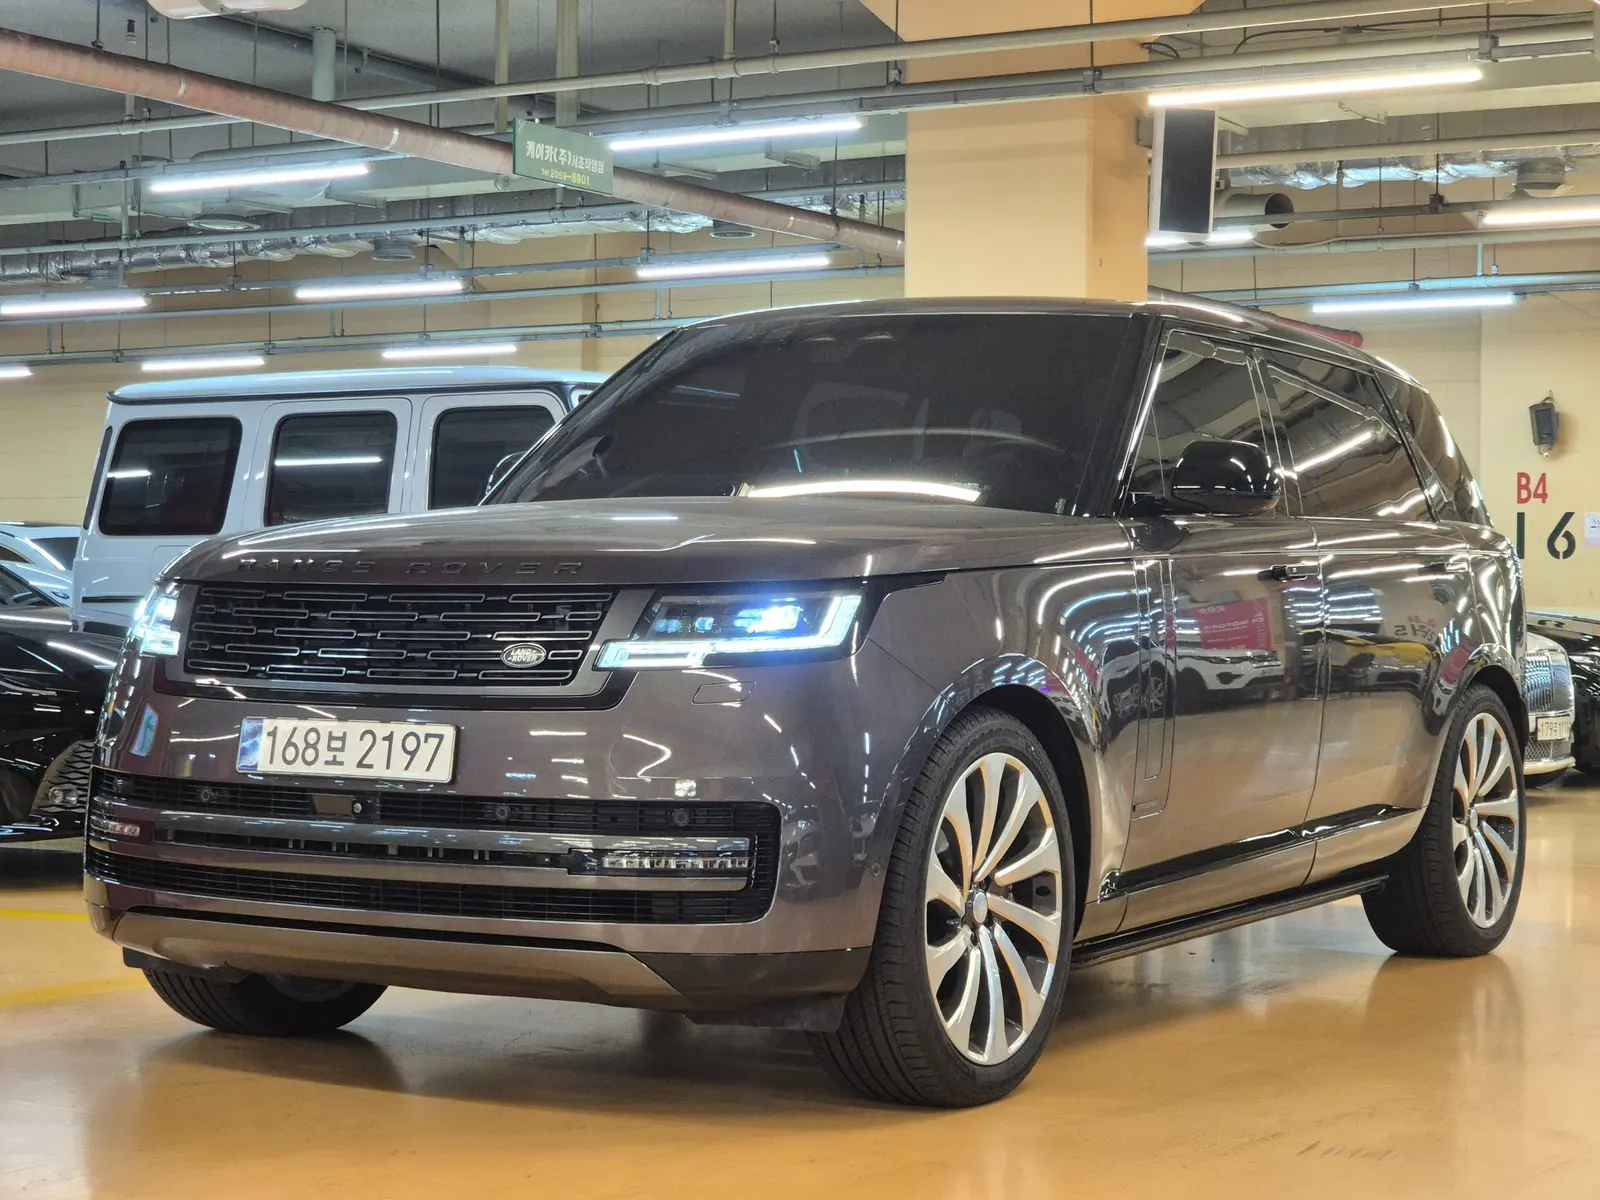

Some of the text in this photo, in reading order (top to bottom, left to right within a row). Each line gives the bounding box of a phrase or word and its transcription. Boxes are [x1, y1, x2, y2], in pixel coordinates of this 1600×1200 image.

[550, 169, 590, 186] 2059-8901
[1516, 472, 1548, 504] B4
[1516, 511, 1576, 560] 16
[238, 559, 583, 575] RANGE ROVER
[510, 648, 532, 656] LAND
[511, 655, 538, 663] ROVER
[265, 725, 445, 772] 168보 2197
